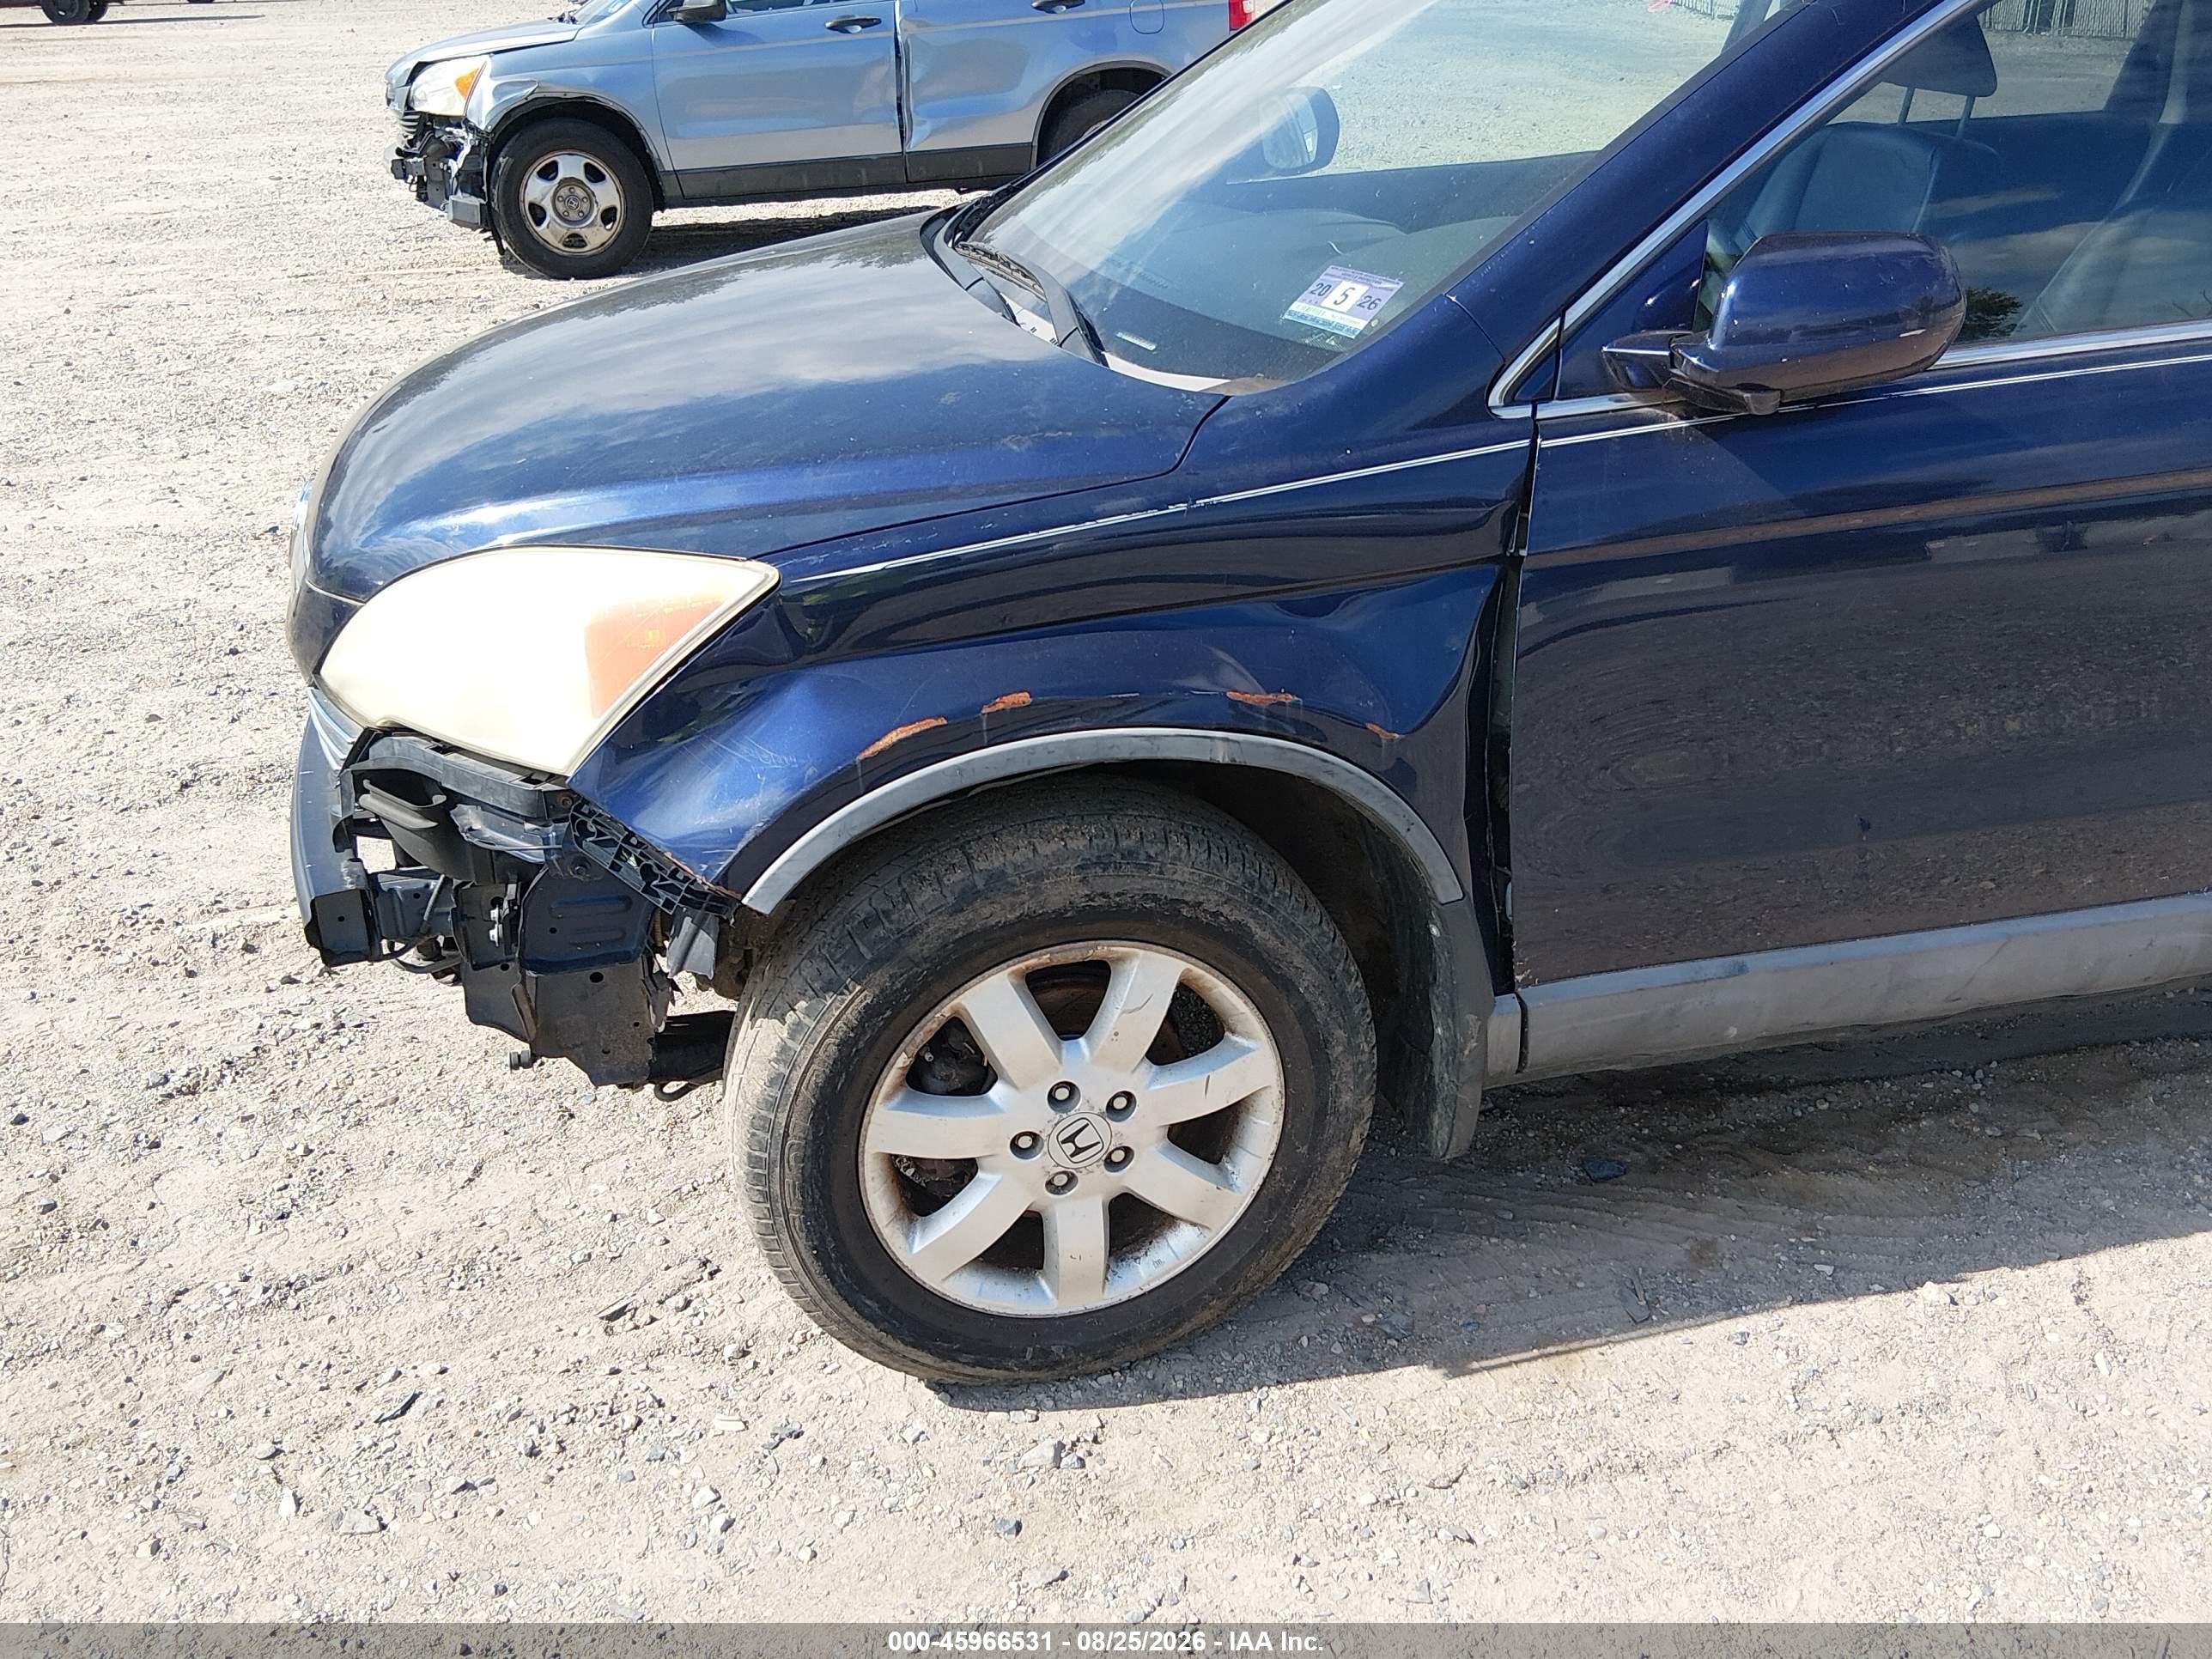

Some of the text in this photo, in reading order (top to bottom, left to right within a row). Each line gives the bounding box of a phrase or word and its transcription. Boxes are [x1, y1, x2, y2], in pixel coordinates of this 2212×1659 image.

[1310, 282, 1382, 311] 20 5 26
